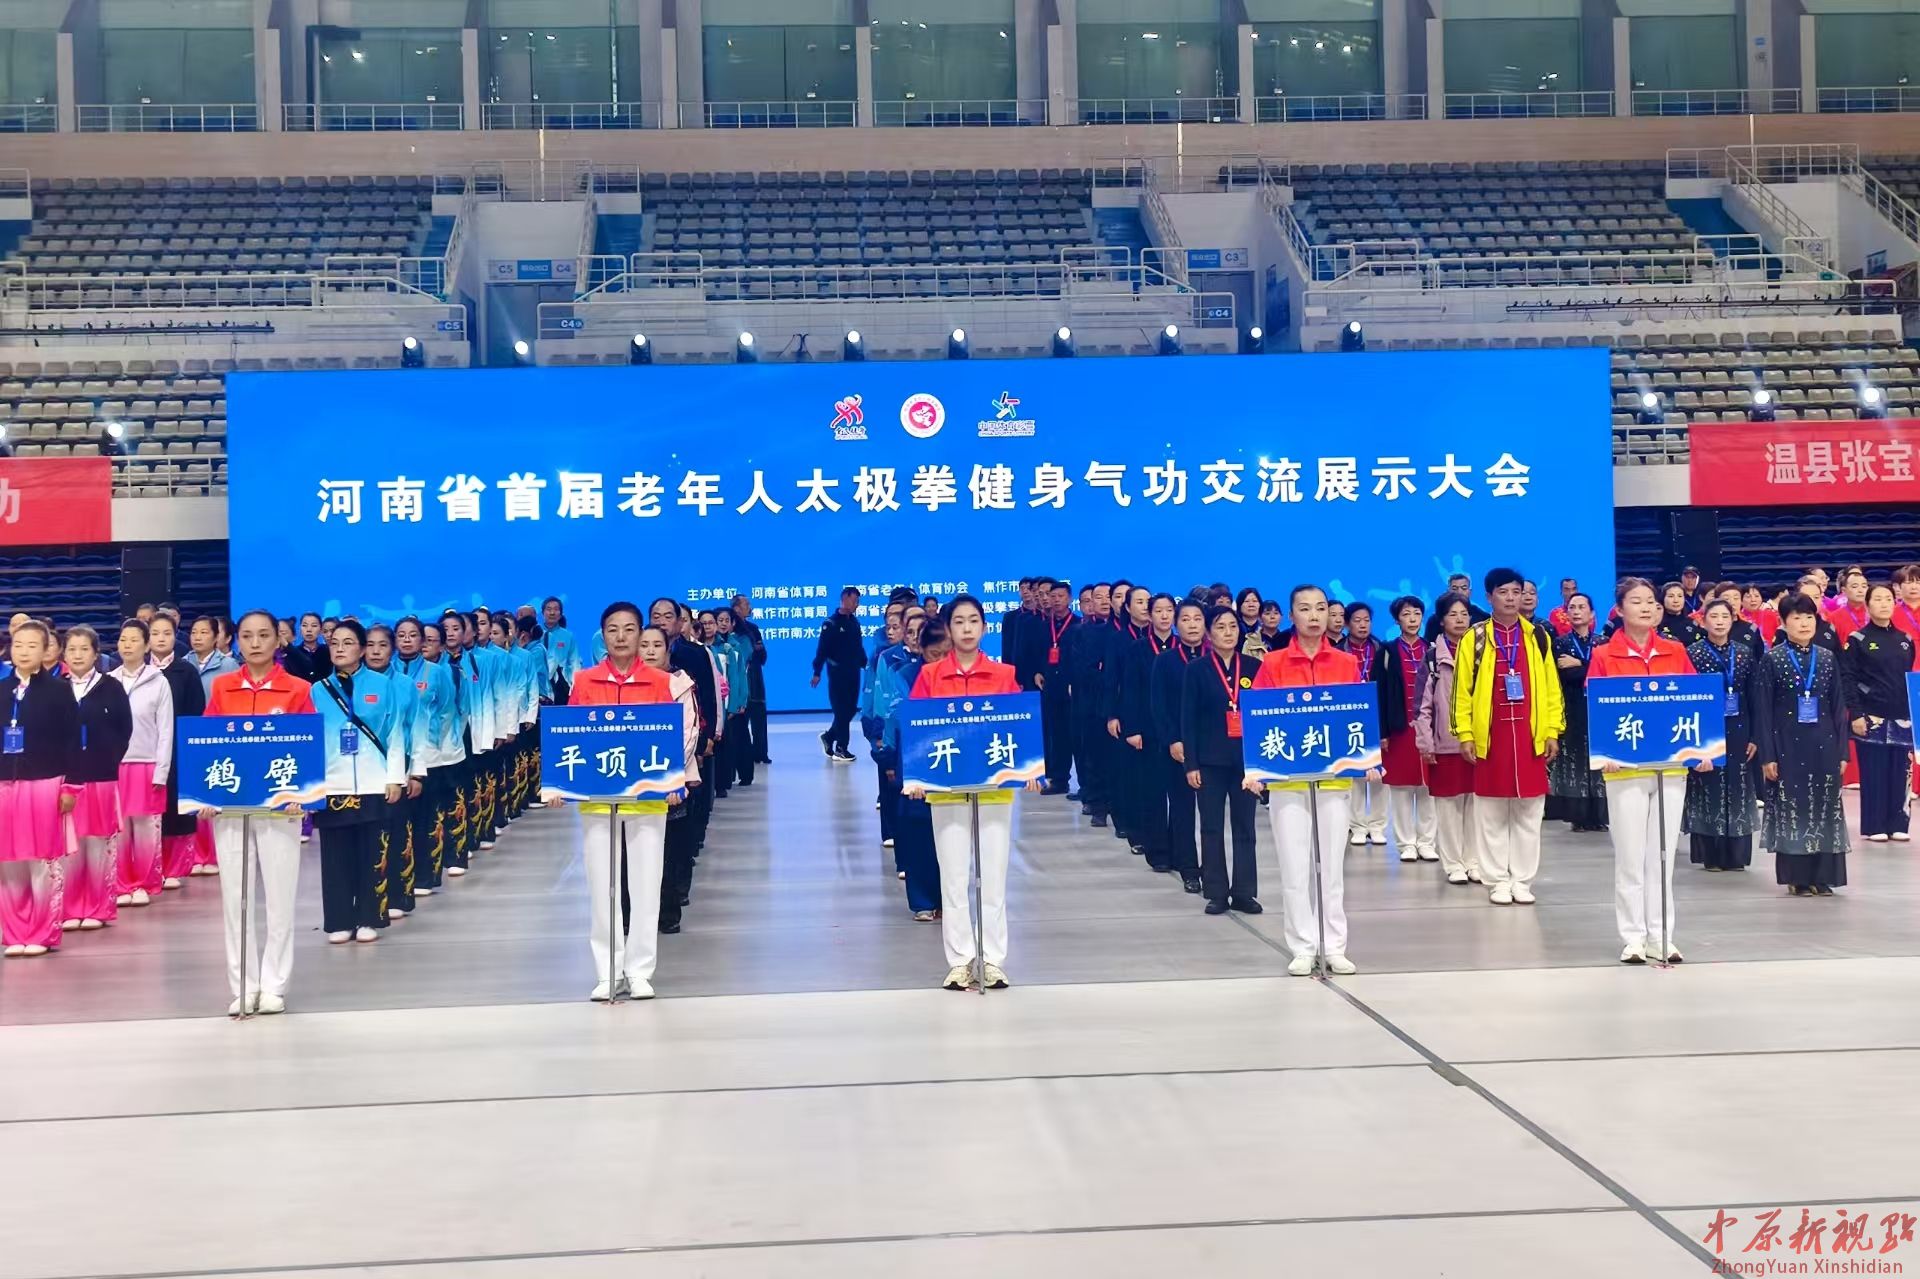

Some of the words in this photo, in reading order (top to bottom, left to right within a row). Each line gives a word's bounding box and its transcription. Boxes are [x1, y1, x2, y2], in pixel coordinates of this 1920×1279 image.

[1225, 253, 1239, 262] C3
[444, 321, 460, 330] C5
[560, 319, 575, 328] C4
[1215, 309, 1229, 317] C4
[1764, 439, 1915, 484] 温县张宝
[317, 452, 1531, 524] 河南省首届老年人太极拳健身气功交流展示大会
[687, 587, 737, 601] 主办单位
[751, 584, 828, 599] 河南省体育局
[751, 605, 828, 619] 焦作市体育局
[1259, 722, 1366, 761] 裁判员
[1614, 711, 1700, 751] 郑州
[555, 745, 670, 781] 平顶山
[928, 732, 1018, 773] 开封
[204, 753, 299, 794] 鹤壁
